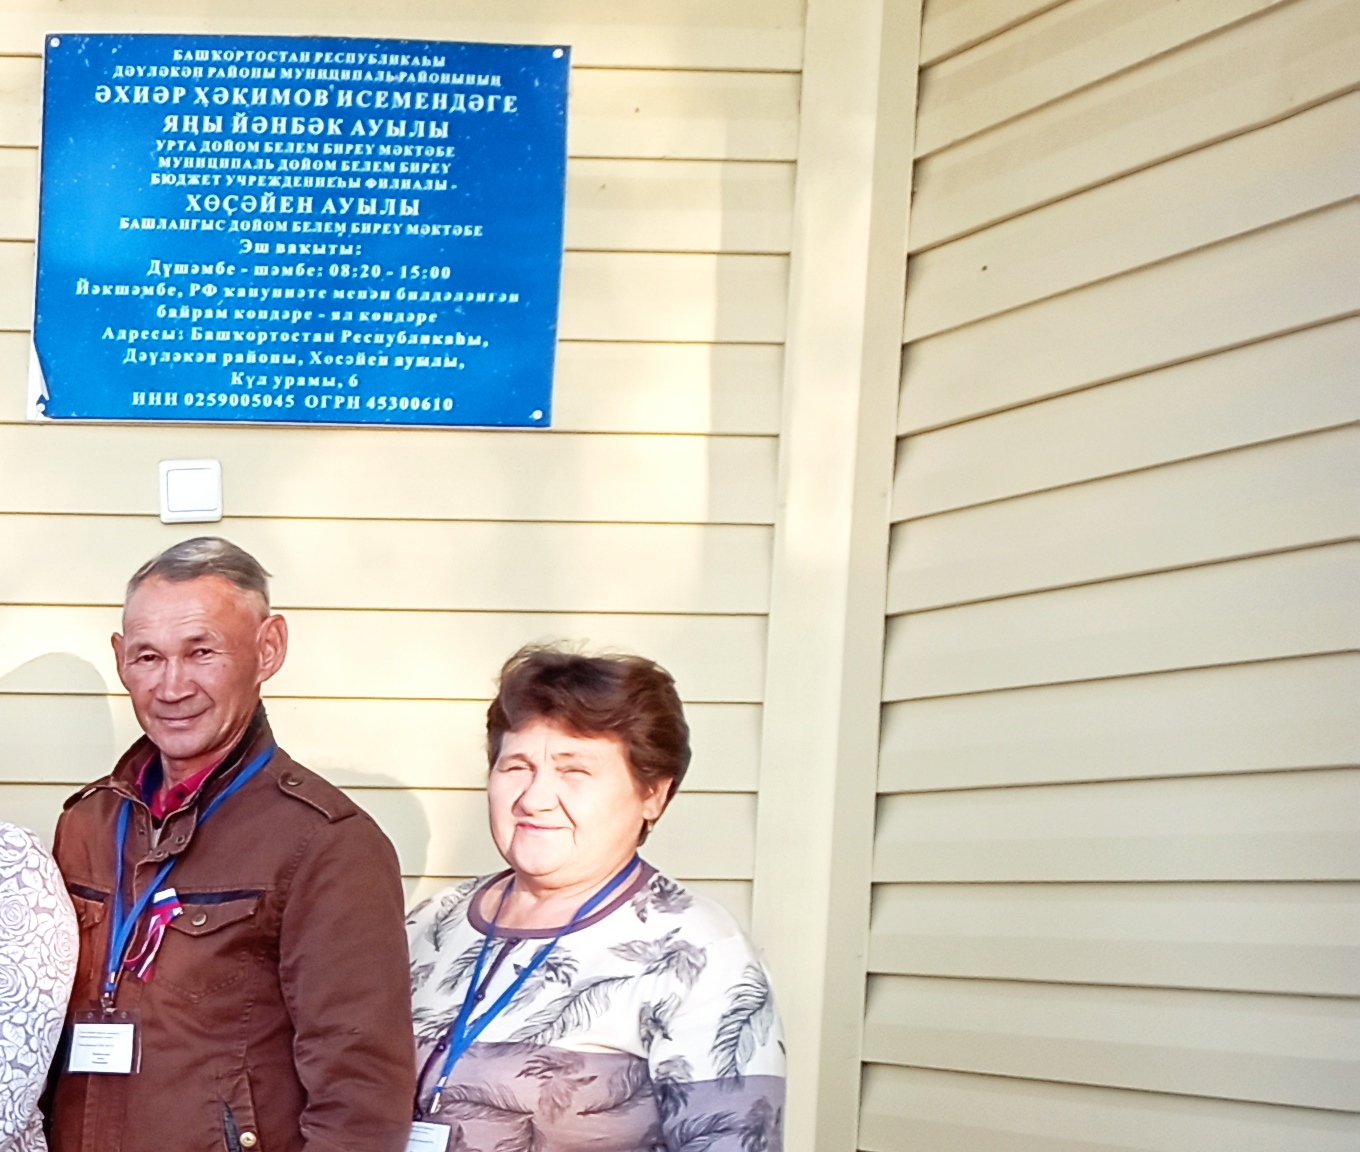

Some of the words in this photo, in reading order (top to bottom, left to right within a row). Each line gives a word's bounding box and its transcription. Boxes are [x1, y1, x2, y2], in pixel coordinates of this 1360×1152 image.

[112, 65, 204, 78] ДӘҮЛӘКӘН
[207, 65, 276, 79] РАЙОНЫ
[280, 67, 395, 82] МУНИЦИПАЛЬ
[95, 85, 186, 104] ӘХИӘР
[336, 89, 518, 113] ИСЕМЕНДӘГЕ
[162, 114, 223, 135] ЯҢЫ
[232, 112, 343, 136] ЙӘНБӘК
[350, 118, 449, 138] АУЫЛЫ
[156, 139, 196, 152] УРТА
[264, 142, 318, 155] БЕЛЕМ
[379, 145, 456, 158] МӘКТӘБЕ
[158, 156, 274, 170] МУНИЦИПАЛЬ
[341, 161, 396, 173] БЕЛЕМ
[150, 173, 222, 187] БЮДЖЕТ
[365, 178, 448, 191] ФИЛИАЛЫ
[185, 191, 314, 216] ХӨҪӘЙЕН
[321, 197, 420, 216] АУЫЛЫ
[292, 221, 347, 234] БЕЛЕМ
[406, 224, 484, 237] МӘКТӘБЕ
[239, 238, 269, 254] Эш
[254, 263, 323, 277] шәмбе:
[329, 264, 381, 278] 08:20
[399, 265, 451, 280] 15:00
[76, 278, 183, 299] Йәкшәмбе,
[190, 283, 218, 297] РФ
[333, 288, 391, 300] менән
[157, 304, 228, 322] байрам
[331, 310, 353, 321] ял
[102, 327, 184, 343] Адресы:
[341, 329, 489, 348] Республикаһы,
[222, 351, 304, 367] районы,
[394, 356, 465, 371] ауылы,
[230, 371, 267, 389] Күл
[273, 376, 343, 390] урамы,
[348, 374, 359, 387] 6
[132, 392, 178, 407] ИНН
[304, 395, 361, 410] ОГРН
[366, 395, 453, 412] 45300610
